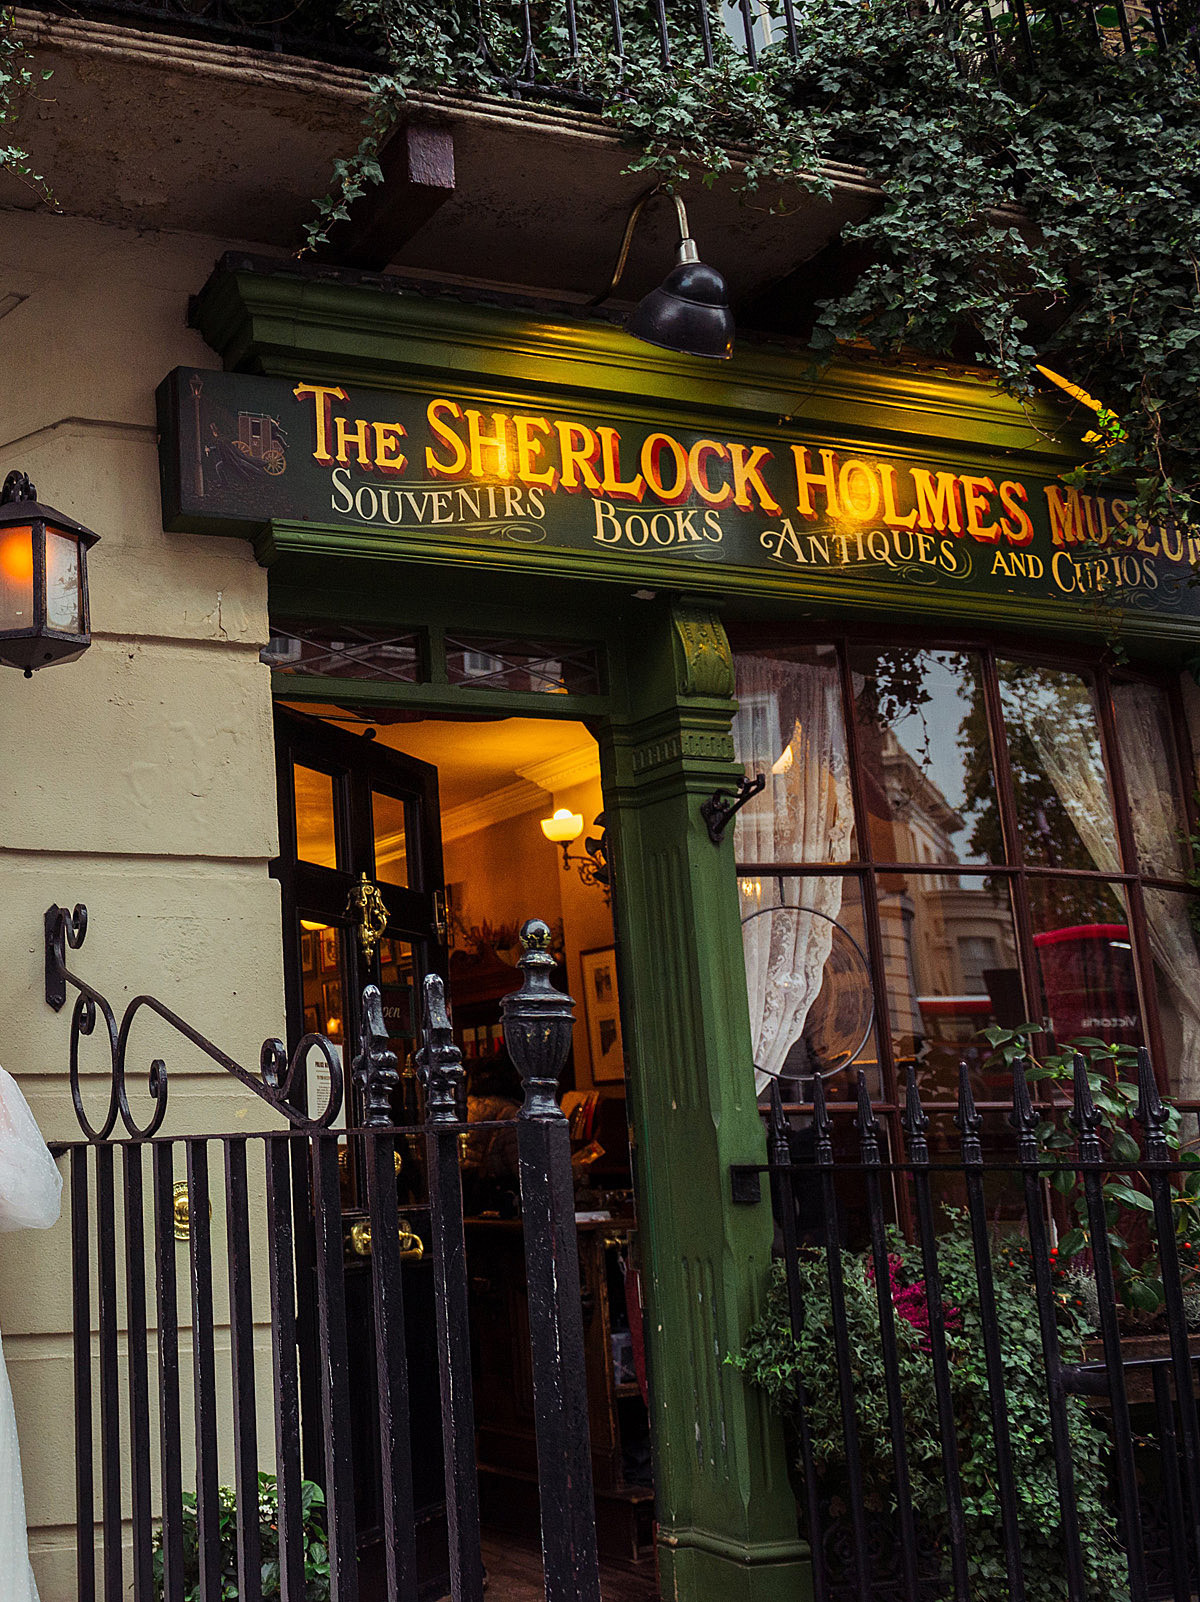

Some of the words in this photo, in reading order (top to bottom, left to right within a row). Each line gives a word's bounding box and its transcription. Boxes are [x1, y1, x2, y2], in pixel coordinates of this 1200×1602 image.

[293, 382, 407, 474] THE
[425, 399, 782, 517] SHERLOCK
[790, 445, 1035, 547] HOLMES
[331, 467, 546, 525] SOUVENIRS
[591, 497, 723, 547] BOOKS
[760, 518, 958, 572] ANTIQUES
[990, 550, 1044, 579] AND
[1051, 551, 1158, 593] CURIOS
[383, 1006, 401, 1019] pen
